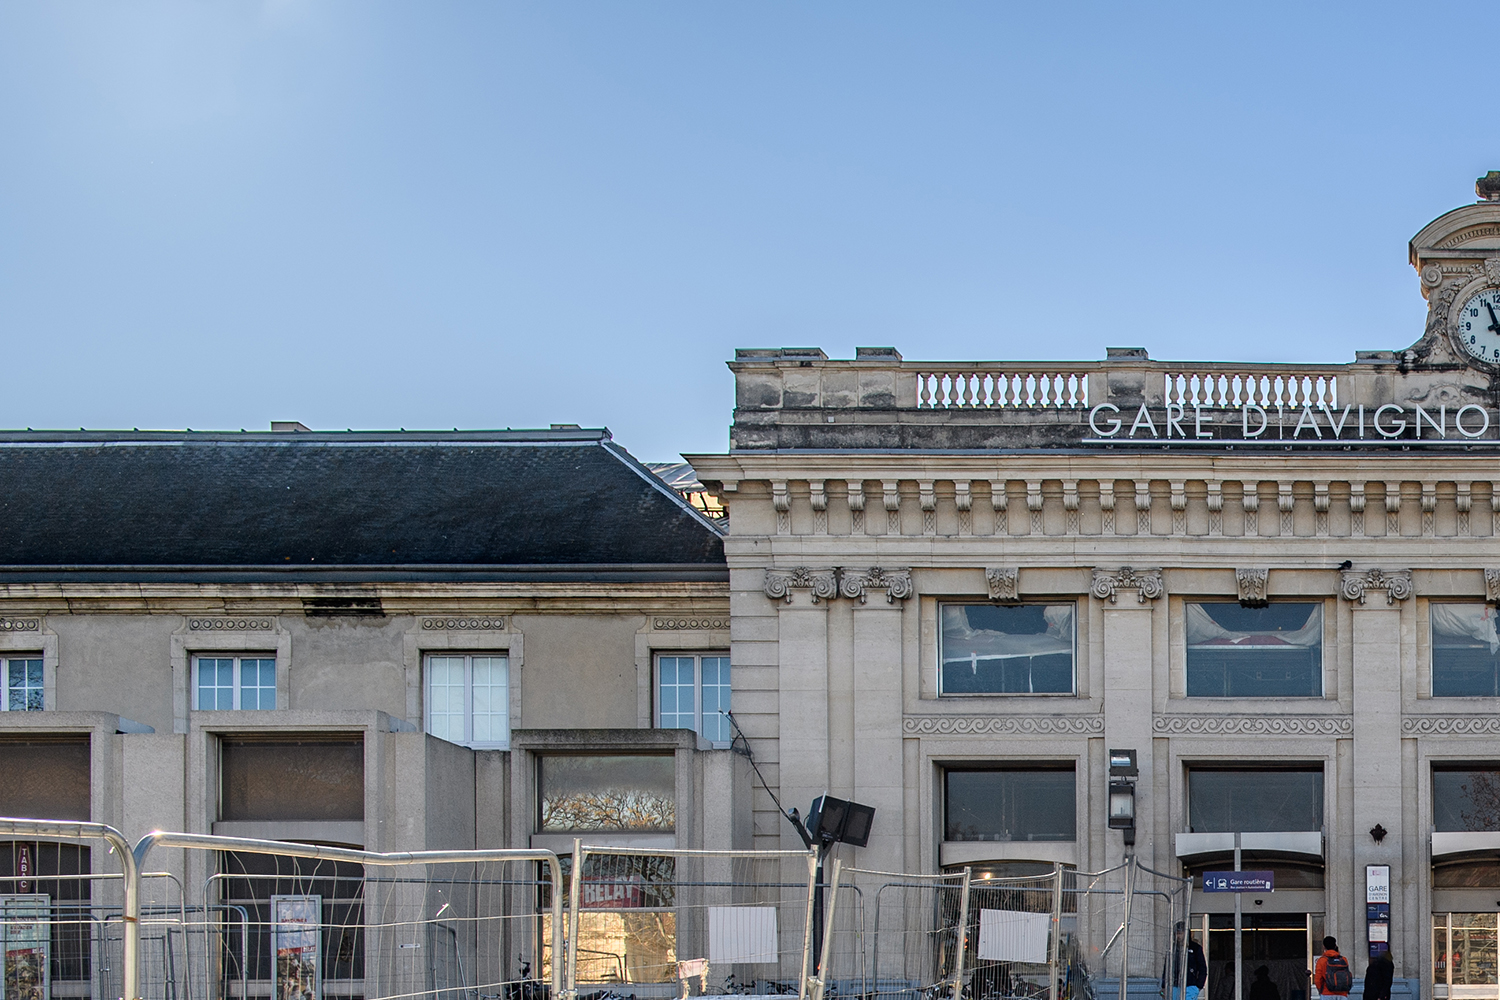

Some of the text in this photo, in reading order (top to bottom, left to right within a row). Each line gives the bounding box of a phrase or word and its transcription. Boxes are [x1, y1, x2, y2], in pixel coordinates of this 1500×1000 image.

[1480, 298, 1487, 307] 11
[1492, 294, 1500, 303] 12
[1470, 308, 1478, 317] 10
[1466, 322, 1472, 331] 9
[1470, 335, 1476, 344] 8
[1480, 345, 1487, 355] 7
[1493, 349, 1500, 358] 6
[1089, 403, 1213, 437] GARE
[584, 876, 634, 903] RELAY
